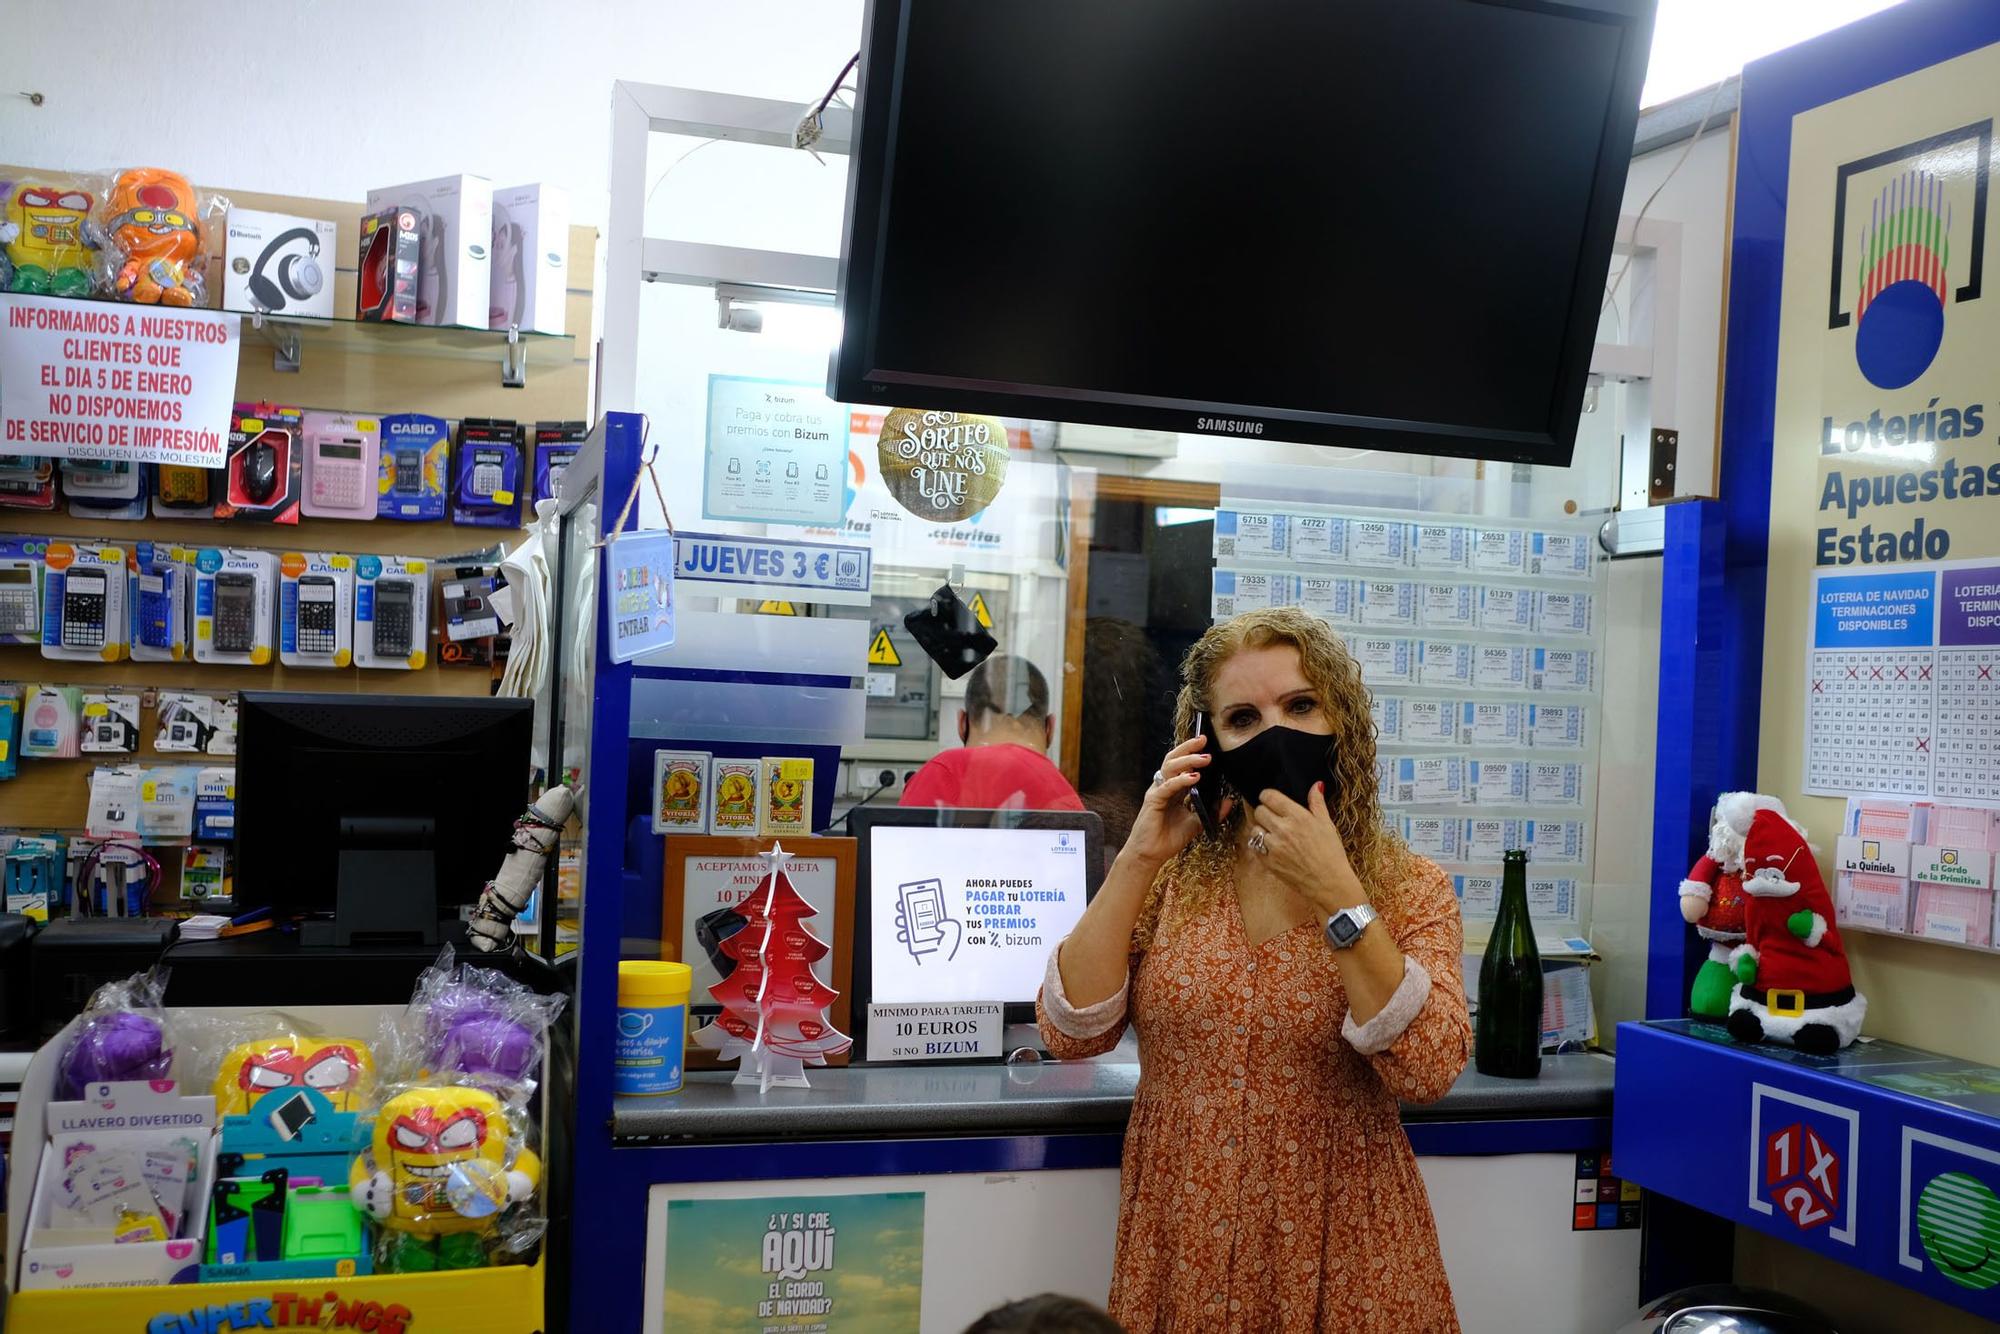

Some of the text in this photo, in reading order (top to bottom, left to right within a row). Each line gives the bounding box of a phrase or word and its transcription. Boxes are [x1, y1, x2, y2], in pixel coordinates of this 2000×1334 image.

[10, 306, 227, 344] INFORMAMOS A NUESTROS
[64, 338, 181, 367] CLIENTES QUE
[41, 365, 192, 395] EL DIA 5 DE ENERO
[774, 395, 795, 404] bizum
[49, 394, 182, 422] NO DISPONEMOS
[735, 407, 822, 425] Paga y cobra tus
[391, 423, 436, 434] CASIO
[727, 424, 829, 441] premios con Bizum
[1197, 417, 1264, 435] SAMSUNG
[1822, 397, 1984, 455] Loterías
[6, 420, 25, 441] DE
[30, 420, 103, 445] SERVICIO
[109, 425, 128, 446] DE
[133, 427, 222, 453] IMPRESIÓN.
[899, 422, 989, 459] SORTEO
[68, 446, 222, 466] DISCULPEN LAS MOLESTIAS
[920, 447, 985, 475] QUE NOS
[911, 467, 968, 510] UNE
[1819, 457, 2000, 519] Apuestas
[1242, 516, 1268, 525] 67153
[1301, 519, 1326, 527] 47727
[1361, 523, 1385, 532] 12450
[1423, 528, 1447, 537] 97825
[1816, 518, 1950, 566] Estado
[227, 561, 259, 569] CASIO
[684, 545, 829, 580] JUEVES 3 €
[1241, 576, 1266, 584] 79335
[1307, 580, 1331, 588] 17577
[1370, 584, 1394, 593] 14236
[1821, 588, 1929, 604] LOTERIA DE NAVIDAD
[1832, 604, 1916, 617] TERMINACIONES
[618, 616, 649, 639] ENTRAR
[1838, 619, 1908, 632] DISPONIBLES
[1366, 641, 1391, 650] 91230
[1413, 703, 1437, 712] 05146
[666, 810, 696, 818] VITORIA
[695, 862, 820, 873] ACEPTAMOS RJETA
[1846, 860, 1896, 874] La Quiniela
[1930, 863, 1968, 875] El Gordo
[732, 875, 764, 885] MINI
[966, 879, 1033, 888] AHORA PUEDES
[1469, 879, 1492, 888] 30720
[1917, 871, 1981, 886] de la Primitiva
[716, 890, 732, 903] 10
[966, 888, 1065, 902] PAGAR TU LOTERÍA
[966, 904, 1021, 915] Y COBRAR
[966, 918, 1036, 929] TUS PREMIOS
[967, 933, 1042, 946] CON bizum
[873, 1005, 1000, 1018] MINIMO PARA TARJETA
[896, 1020, 978, 1037] 10 EUROS
[892, 1040, 979, 1056] SI NO BIZUM
[62, 1113, 203, 1130] LLAVERO DIVERTIDO
[792, 1213, 804, 1229] SI
[808, 1212, 830, 1229] CAE
[762, 1228, 835, 1281] AQUÍ
[769, 1282, 823, 1298] EL GORDO
[758, 1299, 832, 1317] DE NAVIDAD?
